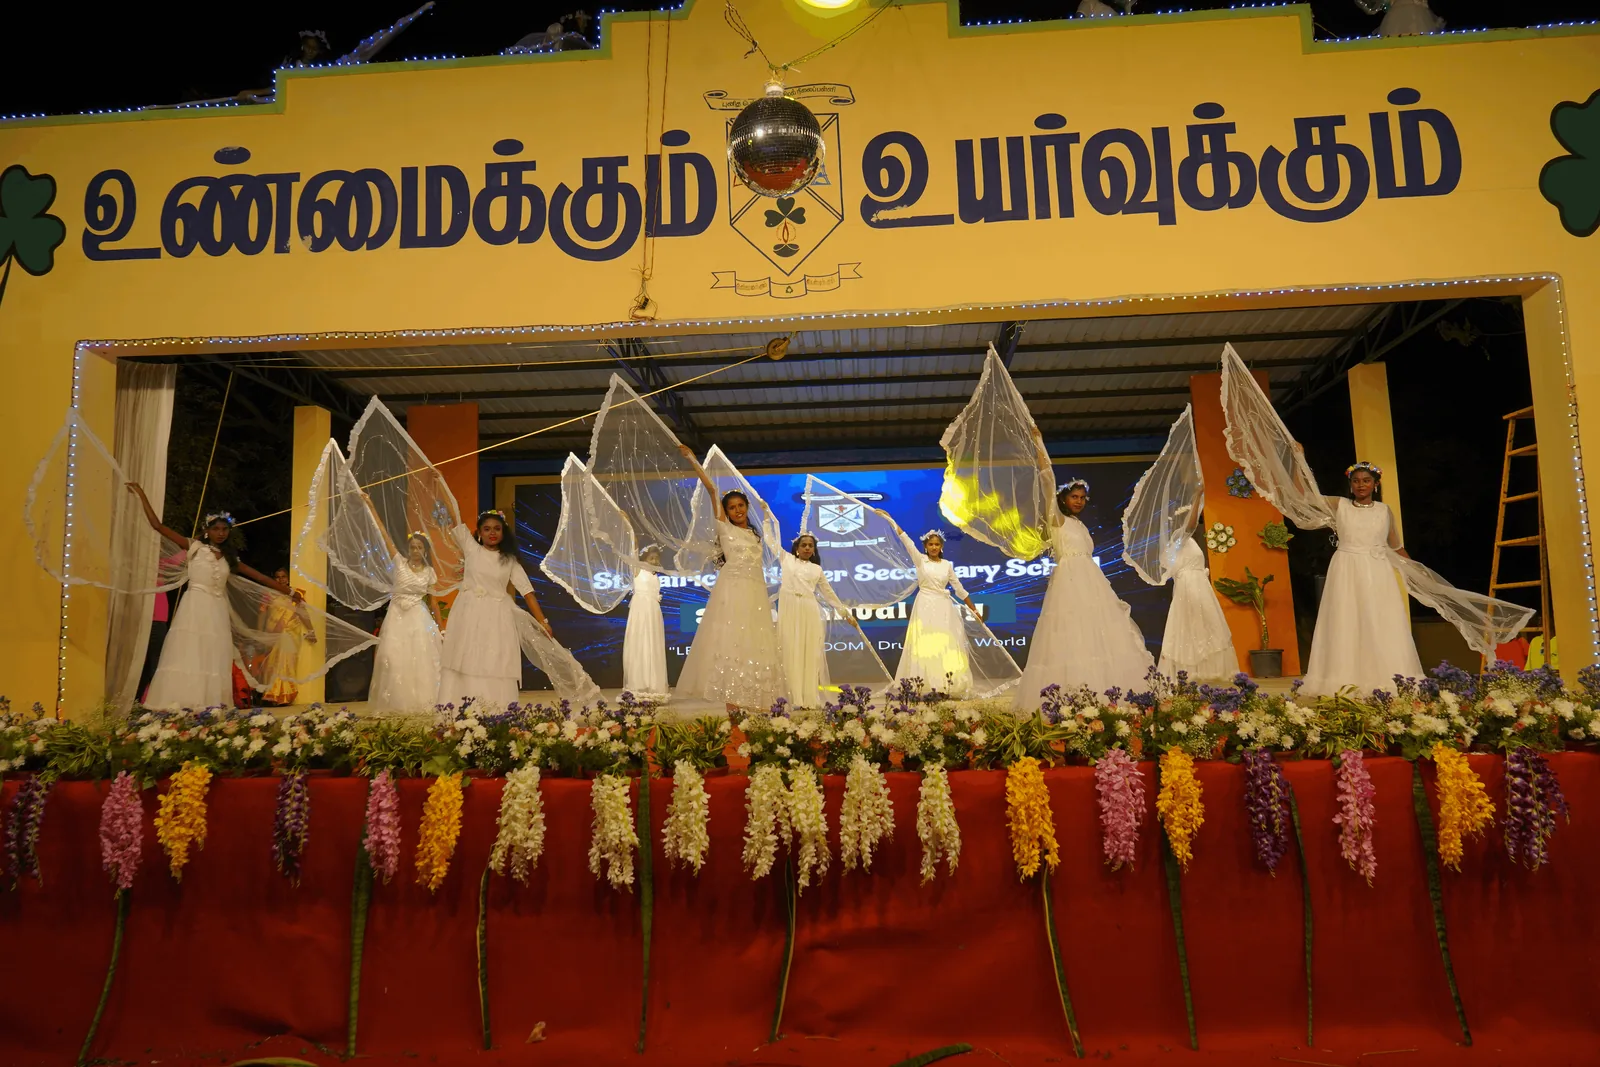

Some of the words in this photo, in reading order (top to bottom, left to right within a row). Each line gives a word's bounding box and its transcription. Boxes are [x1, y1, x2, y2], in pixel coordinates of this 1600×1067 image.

[82, 130, 717, 261] உண்மைக்கும்
[861, 88, 1461, 228] உயர்வுக்கும்
[854, 561, 1000, 583] Secoary
[974, 636, 1026, 647] World
